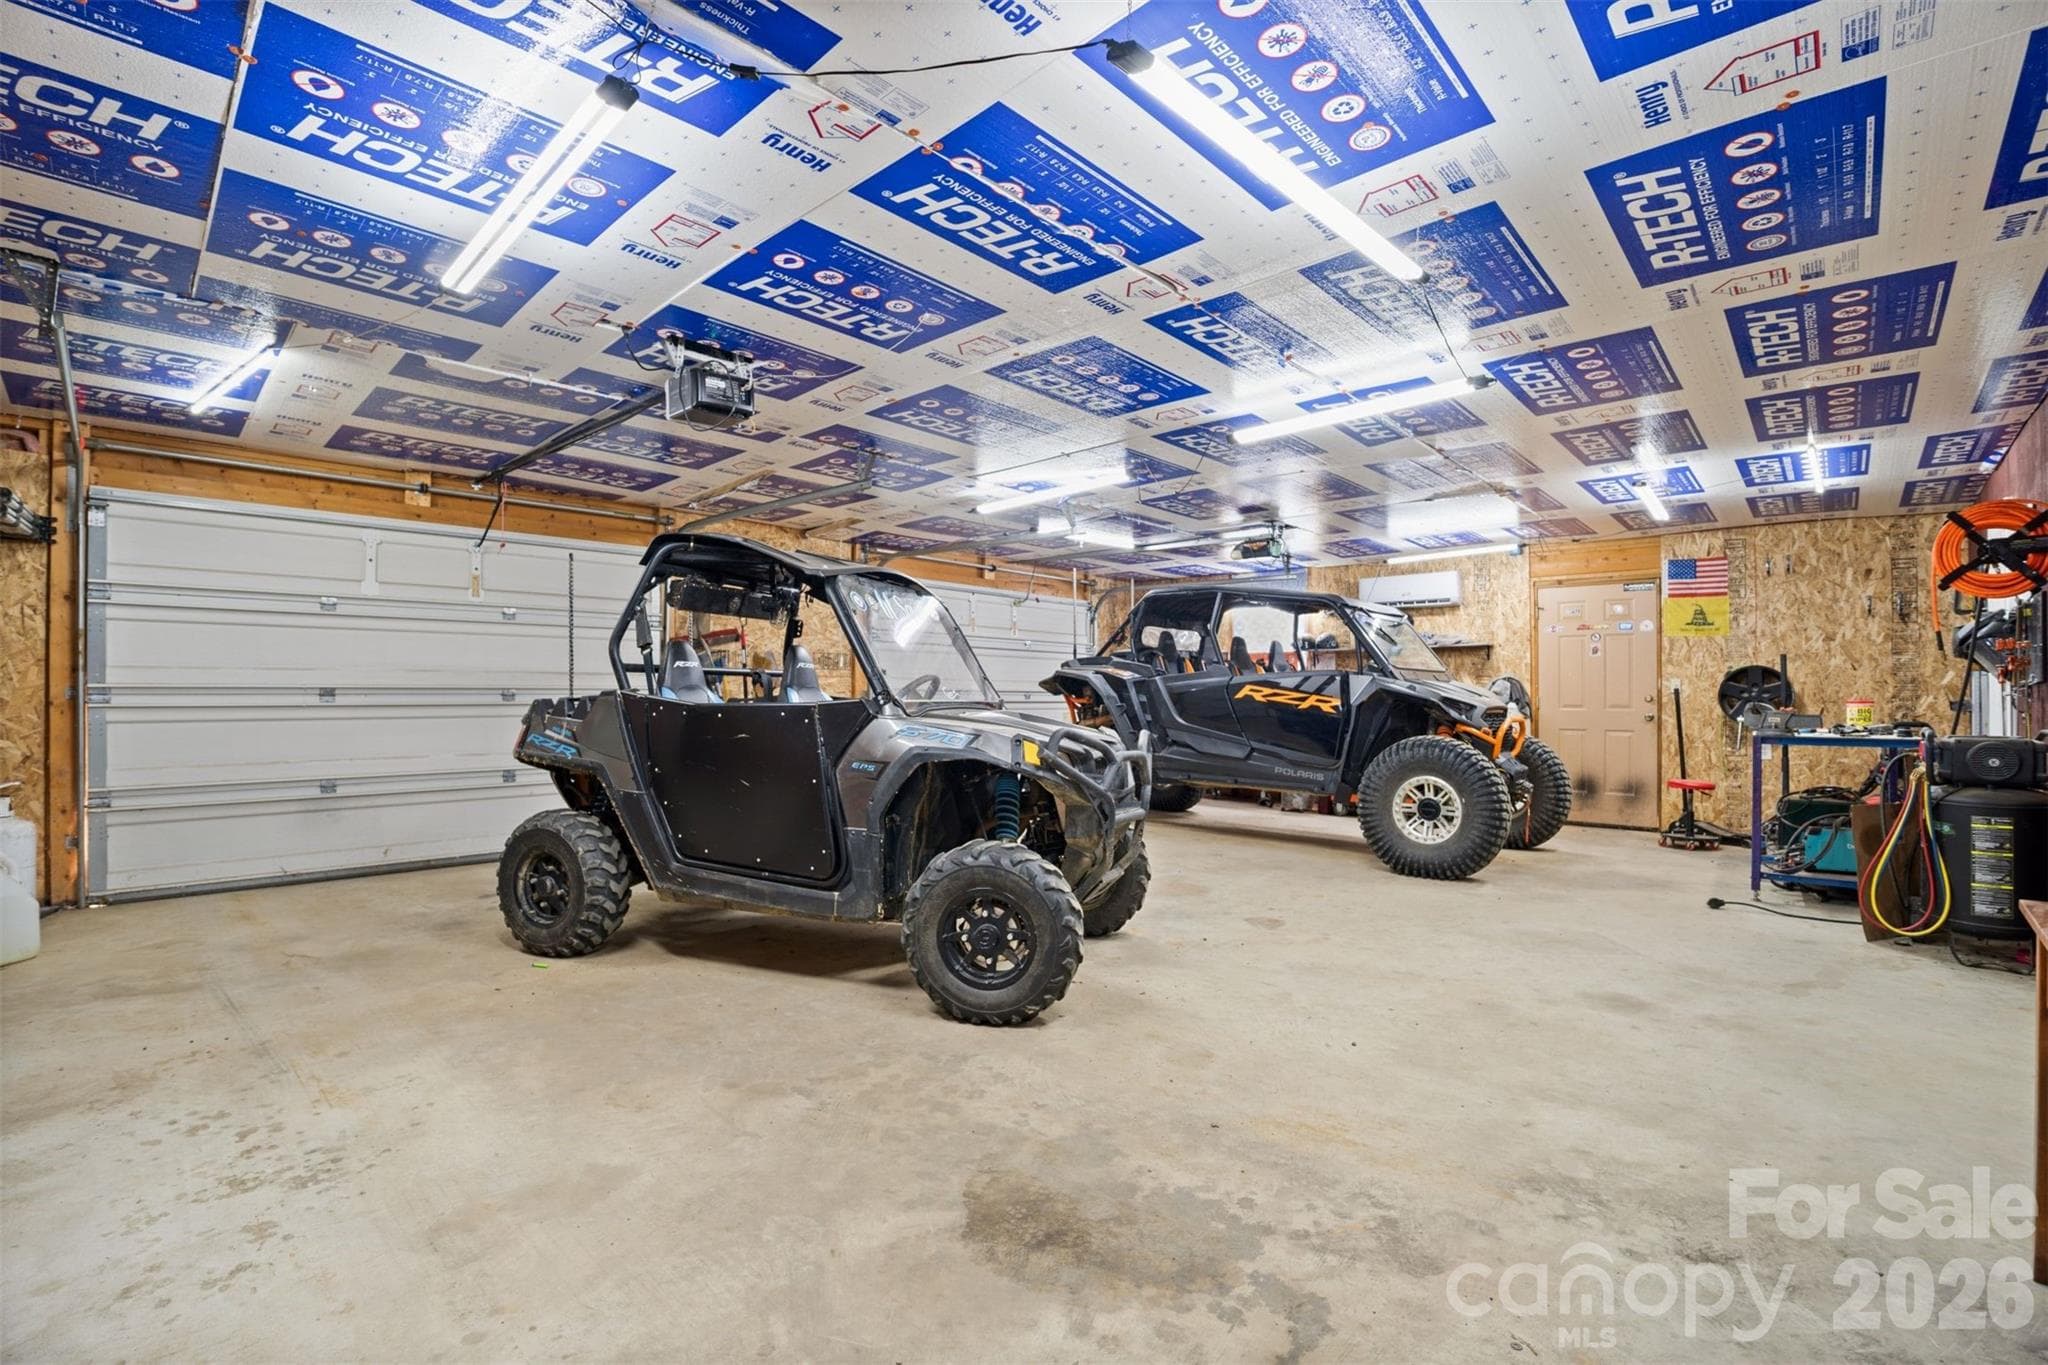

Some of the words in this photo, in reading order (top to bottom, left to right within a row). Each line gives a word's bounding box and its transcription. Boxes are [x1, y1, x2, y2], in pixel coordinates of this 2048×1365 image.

[354, 52, 394, 73] R-11.7
[1187, 17, 1265, 89] EFFICIENCY
[402, 72, 435, 90] R-7.8
[1424, 77, 1449, 101] R-Value
[1254, 84, 1288, 111] FOR
[1634, 79, 1677, 129] Henry
[18, 102, 164, 151] EFFICIENCY
[303, 100, 429, 152] EFFICIENCY
[1276, 107, 1344, 166] ENGINEERED
[760, 127, 833, 177] Henry
[477, 165, 590, 210] ENGRED
[930, 171, 1010, 216] EFFICIENCY
[1687, 155, 1717, 204] EFFICIENCY
[1003, 213, 1034, 230] FOR
[1701, 202, 1721, 221] FOR
[43, 236, 156, 267] EFFICIENCY
[259, 231, 360, 264] EFFICIENCY
[1027, 227, 1099, 266] ENGINEERED
[1706, 218, 1732, 260] ENGINEERED
[364, 261, 398, 274] FOR
[620, 238, 681, 275] Henry
[763, 268, 836, 298] EFFICIENCY
[832, 295, 861, 308] FOR
[1081, 288, 1126, 319] Henry
[528, 320, 583, 346] Henry
[1234, 684, 1341, 714] RZR
[526, 732, 577, 760] RZR
[1274, 765, 1325, 781] POLARIS
